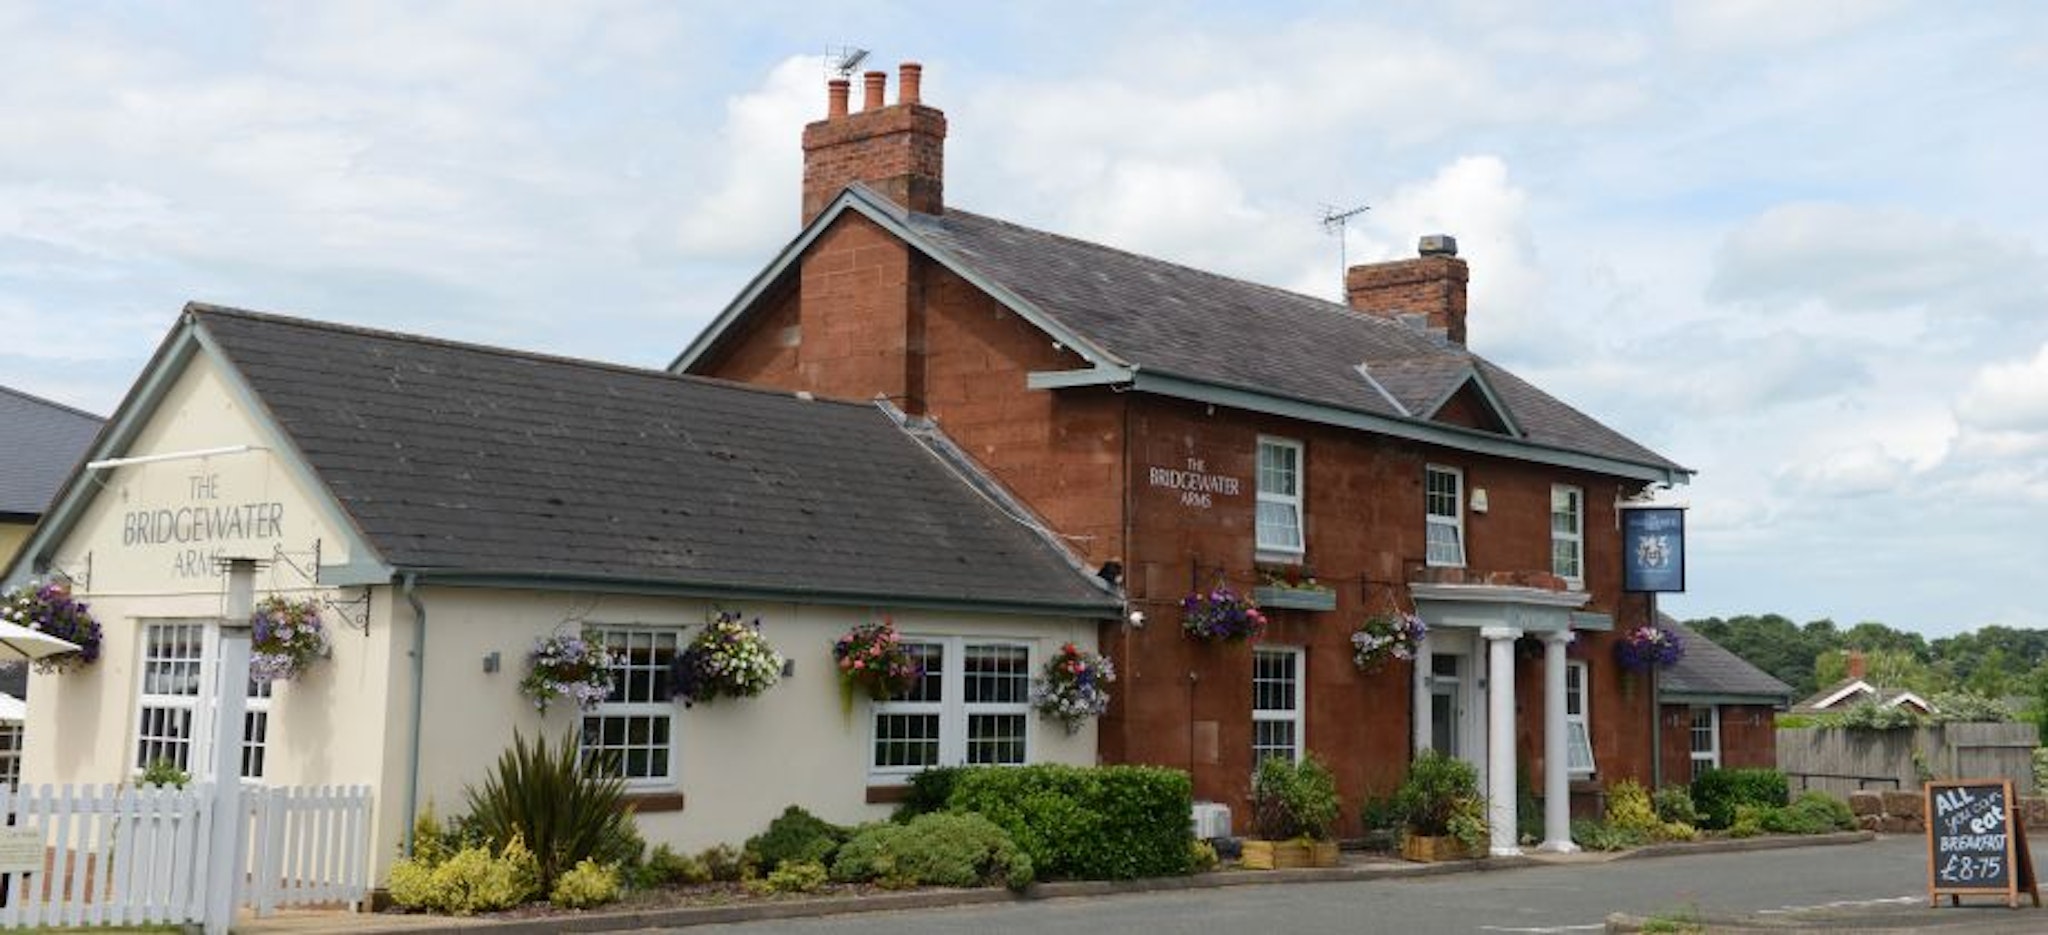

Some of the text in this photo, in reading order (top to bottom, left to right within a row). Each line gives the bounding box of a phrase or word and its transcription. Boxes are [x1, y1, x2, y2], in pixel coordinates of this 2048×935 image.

[1187, 458, 1206, 473] THE
[189, 474, 219, 500] THE
[1149, 466, 1239, 495] BRIDGEWATER
[1180, 491, 1212, 508] ARMS
[123, 502, 284, 547] BRIDGEWATER
[1936, 787, 1975, 817] ALL
[1971, 805, 2006, 834] eat
[1940, 834, 2007, 852] BREAKFAST
